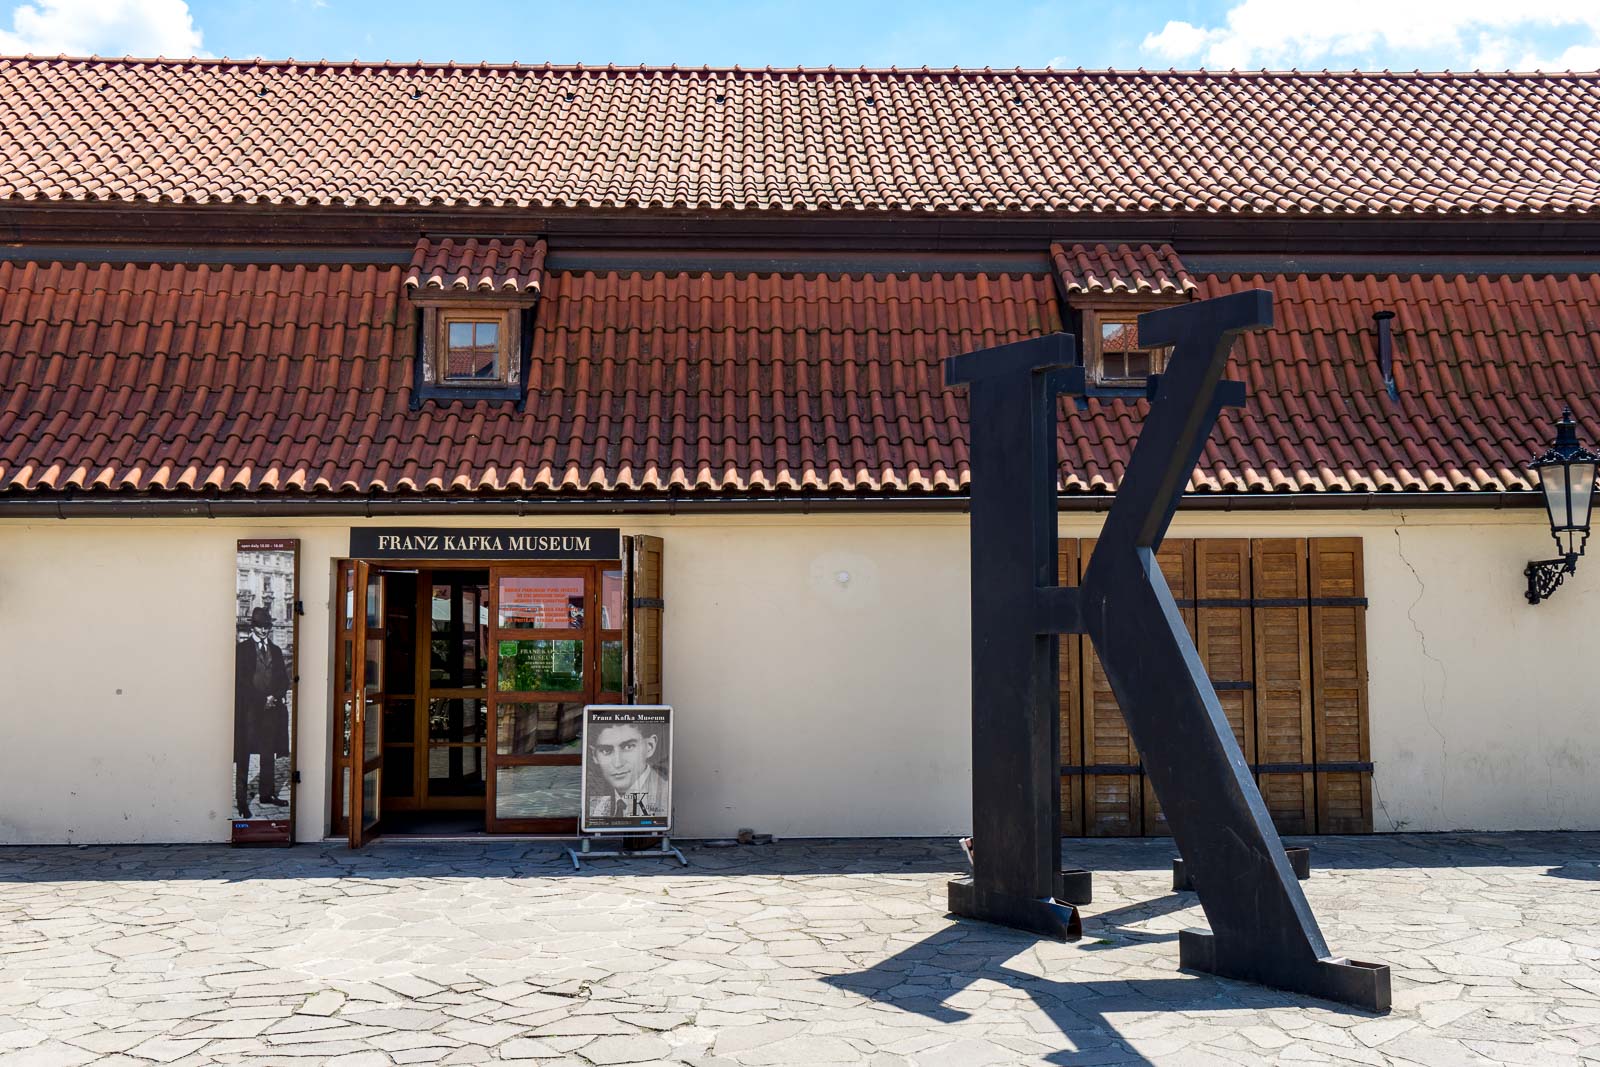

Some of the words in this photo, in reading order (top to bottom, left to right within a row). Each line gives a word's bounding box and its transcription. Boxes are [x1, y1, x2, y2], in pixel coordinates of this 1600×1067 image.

[377, 535, 439, 550] FRANZ
[443, 536, 503, 550] KAFKA
[508, 536, 591, 551] MUSEUM
